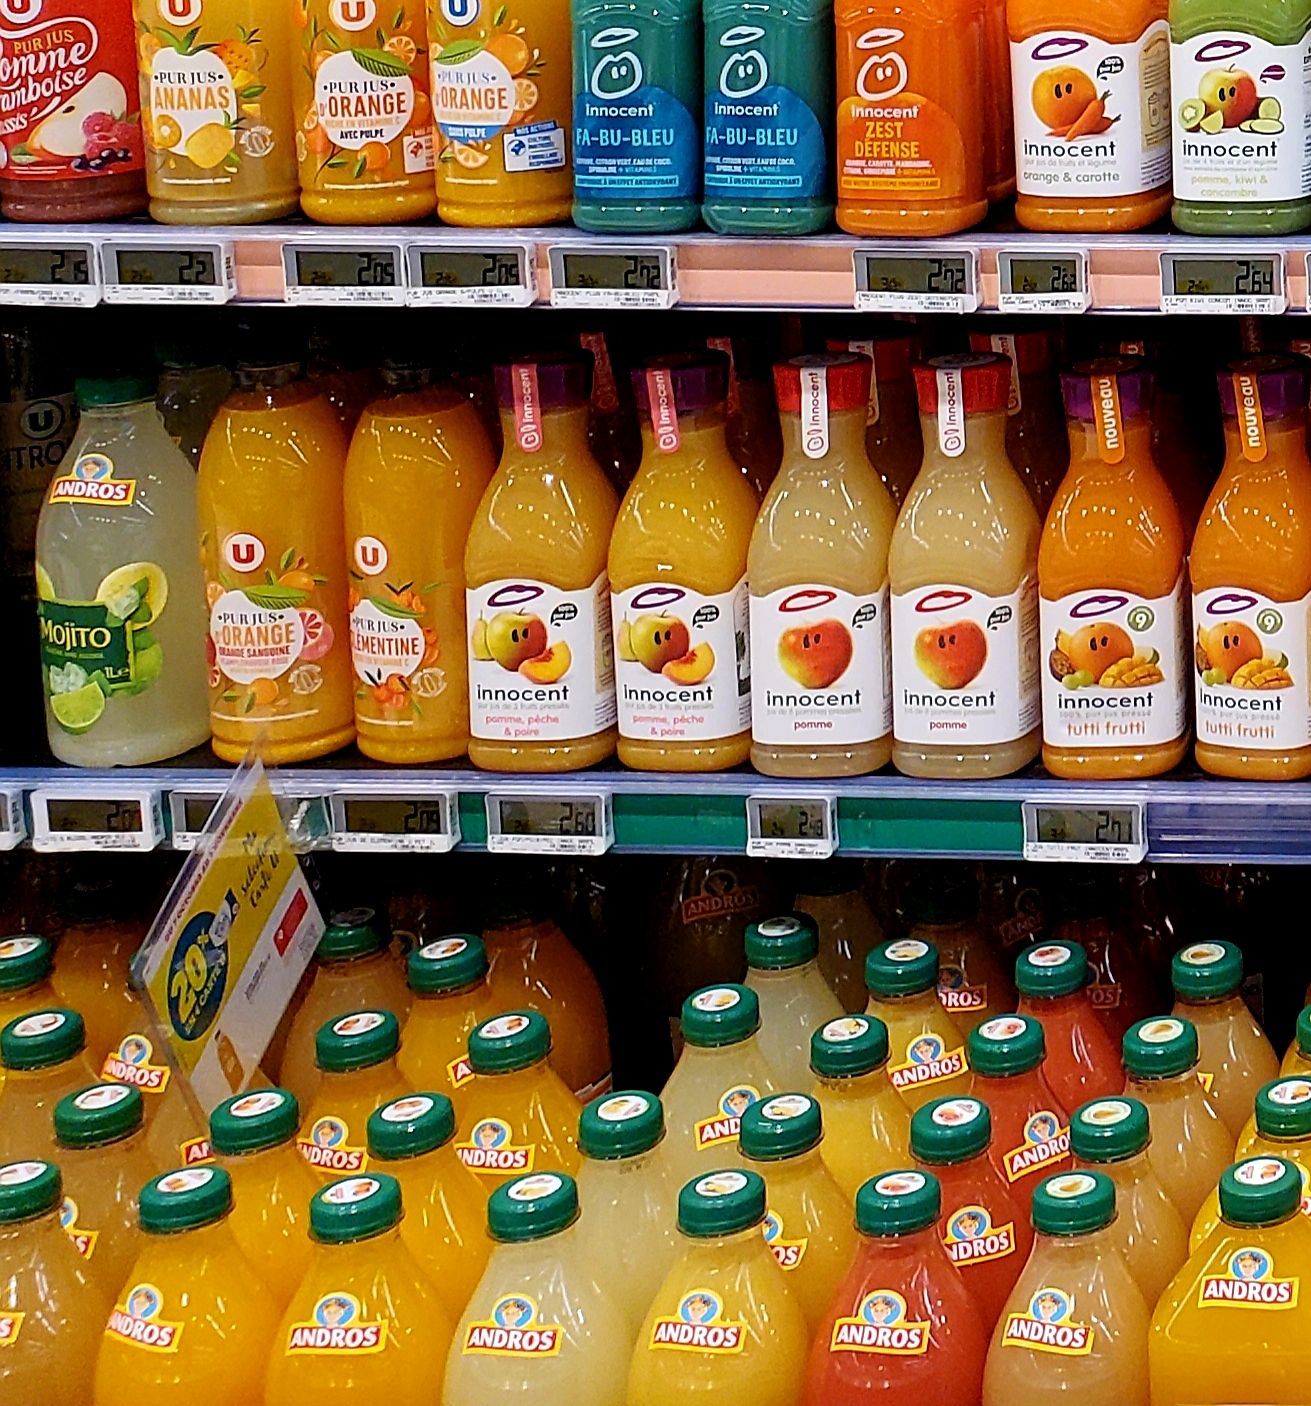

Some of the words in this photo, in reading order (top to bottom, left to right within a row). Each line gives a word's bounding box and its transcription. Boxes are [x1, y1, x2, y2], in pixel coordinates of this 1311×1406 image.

[154, 86, 230, 110] ANANAS
[576, 127, 674, 148] FA-BU-BLEU
[866, 122, 903, 139] ZEST
[855, 136, 919, 158] DÉFENSE
[1024, 140, 1116, 159] innocent
[1024, 171, 1059, 184] orange
[1062, 170, 1072, 182] &
[1075, 170, 1120, 183] carotte
[54, 481, 130, 501] ANDROS
[477, 684, 569, 703] innocent
[794, 720, 833, 731] pomme
[1067, 721, 1100, 736] tutti
[1105, 720, 1146, 736] frutti
[891, 1055, 961, 1084] ANDROS
[290, 1327, 379, 1349] ANDROS
